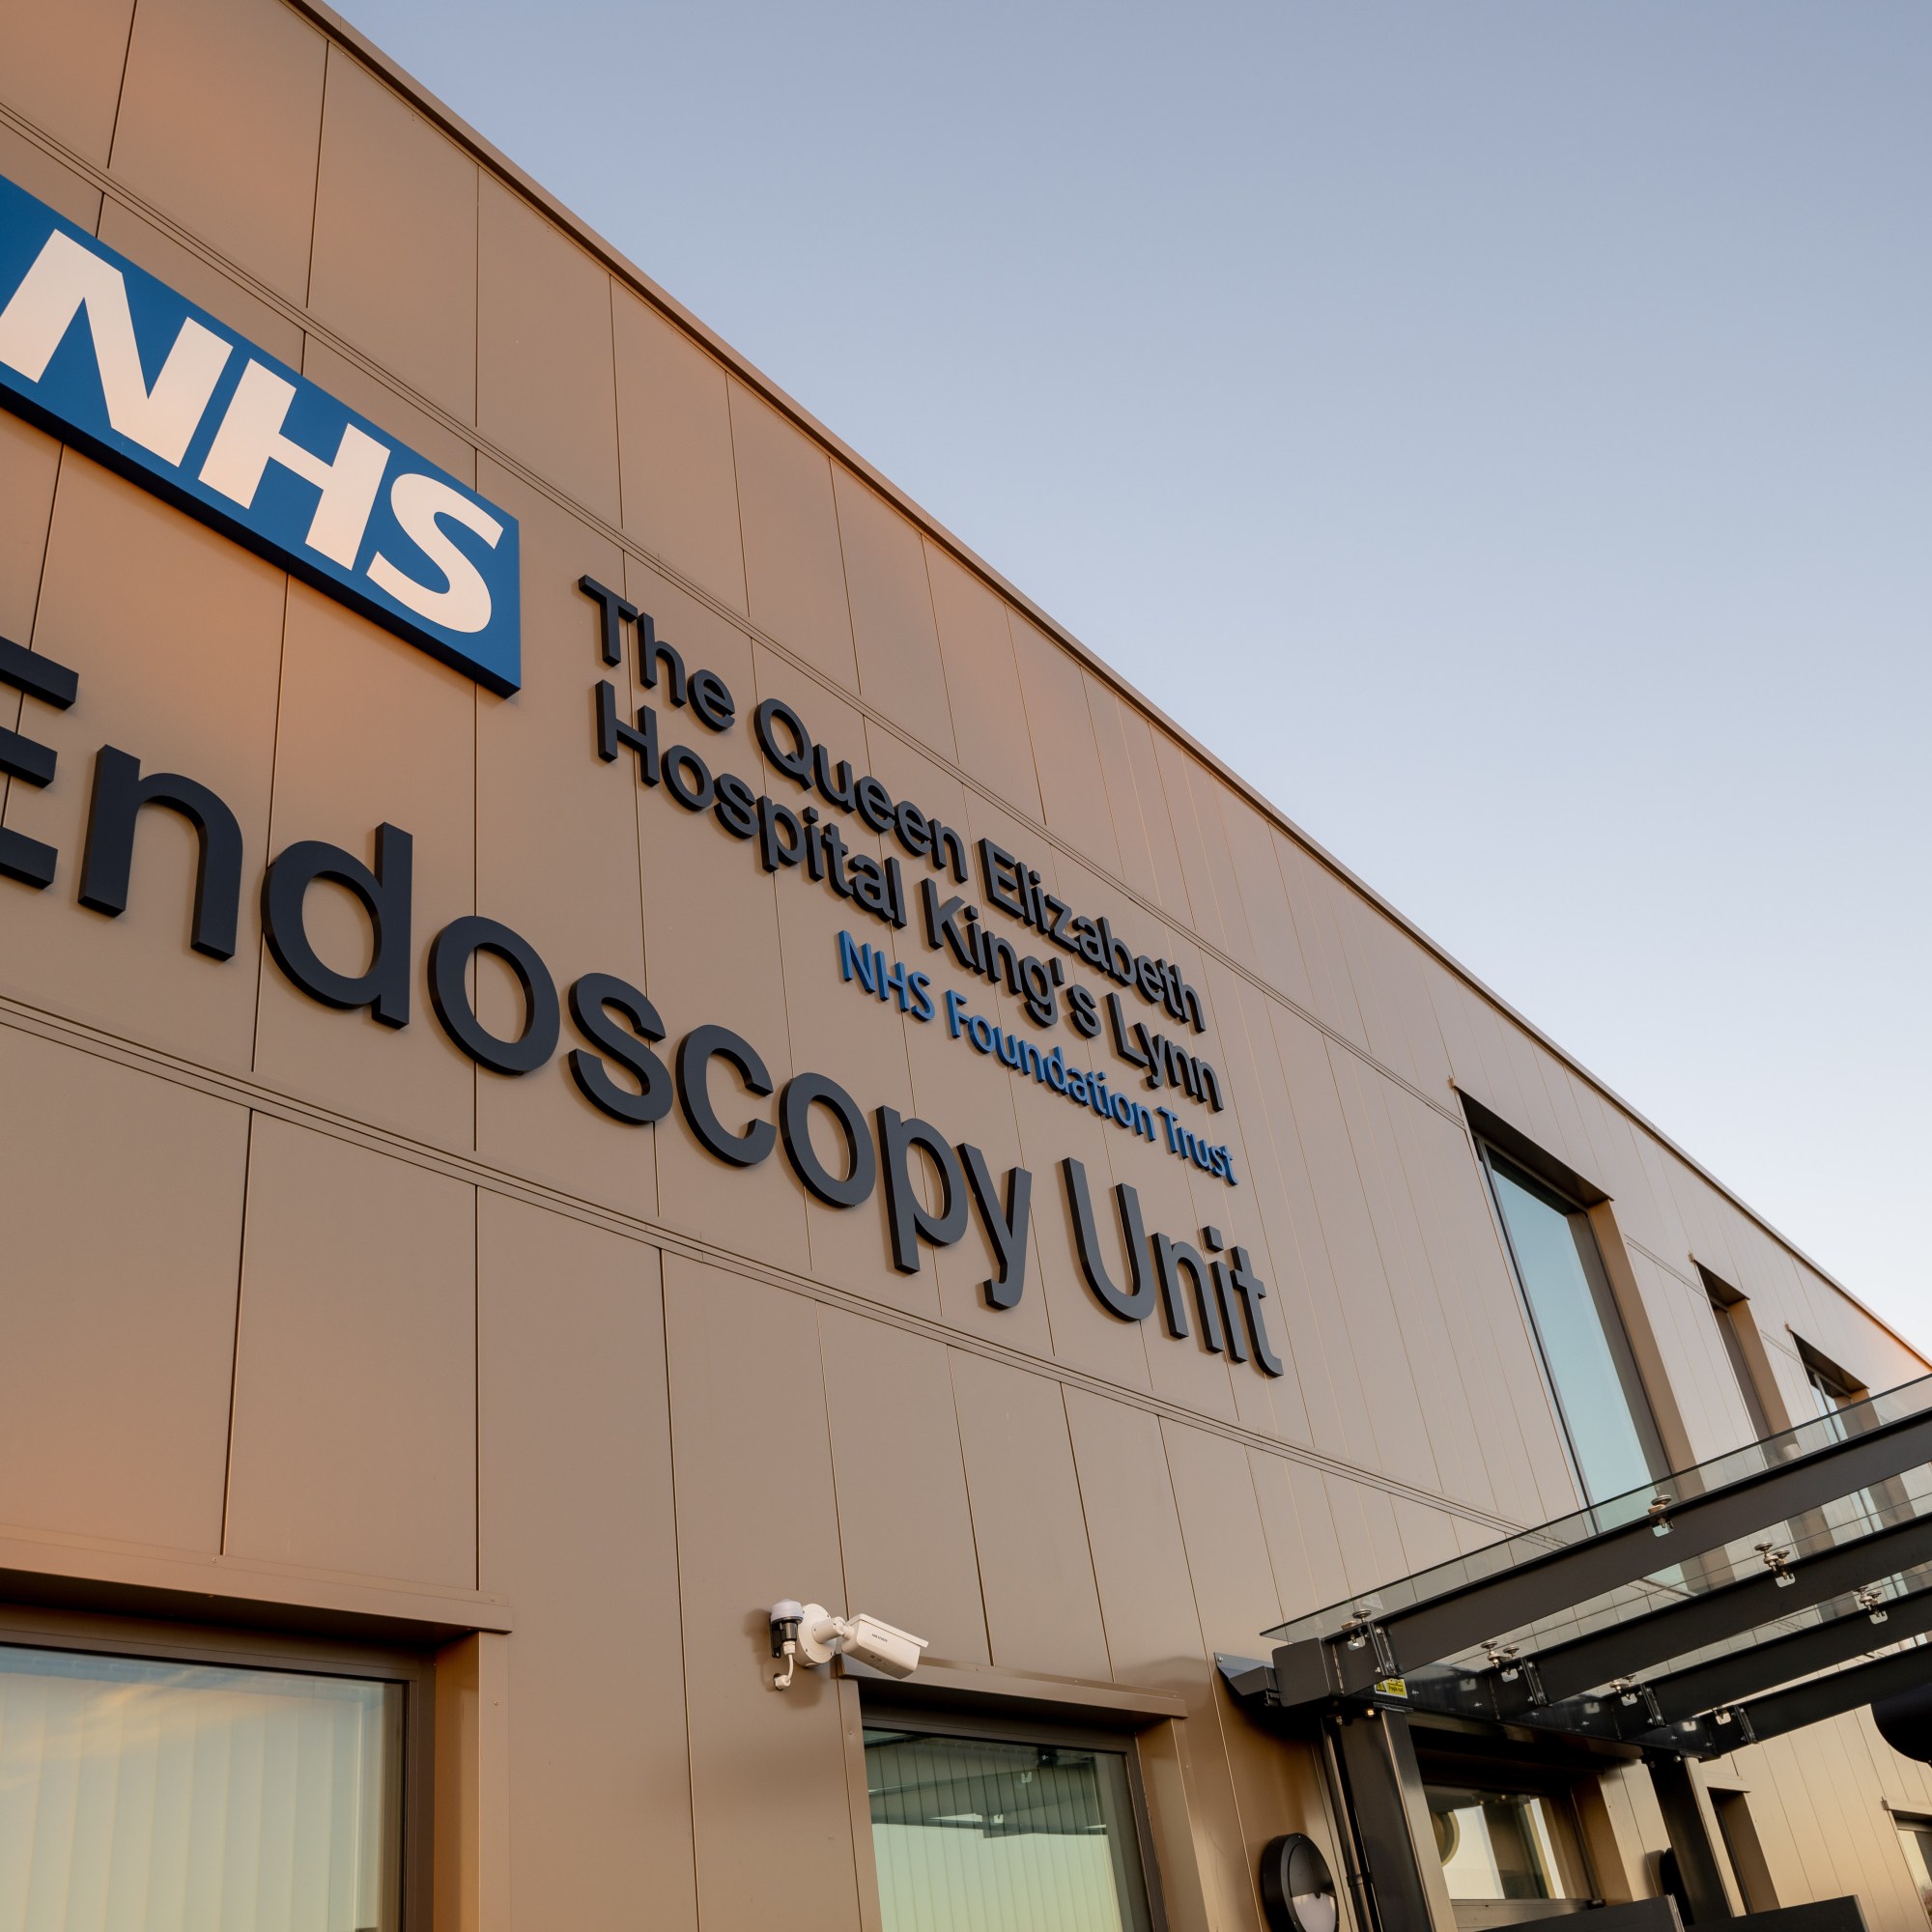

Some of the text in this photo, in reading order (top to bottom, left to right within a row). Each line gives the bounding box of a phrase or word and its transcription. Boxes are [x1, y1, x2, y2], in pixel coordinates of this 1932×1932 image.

[0, 228, 503, 633] NHS
[579, 575, 1207, 1033] The Queen Elizabeth
[595, 679, 1225, 1113] Hospital King's Lynn
[838, 930, 1238, 1186] NHS Foundation Trust
[1062, 1156, 1284, 1378] Unit
